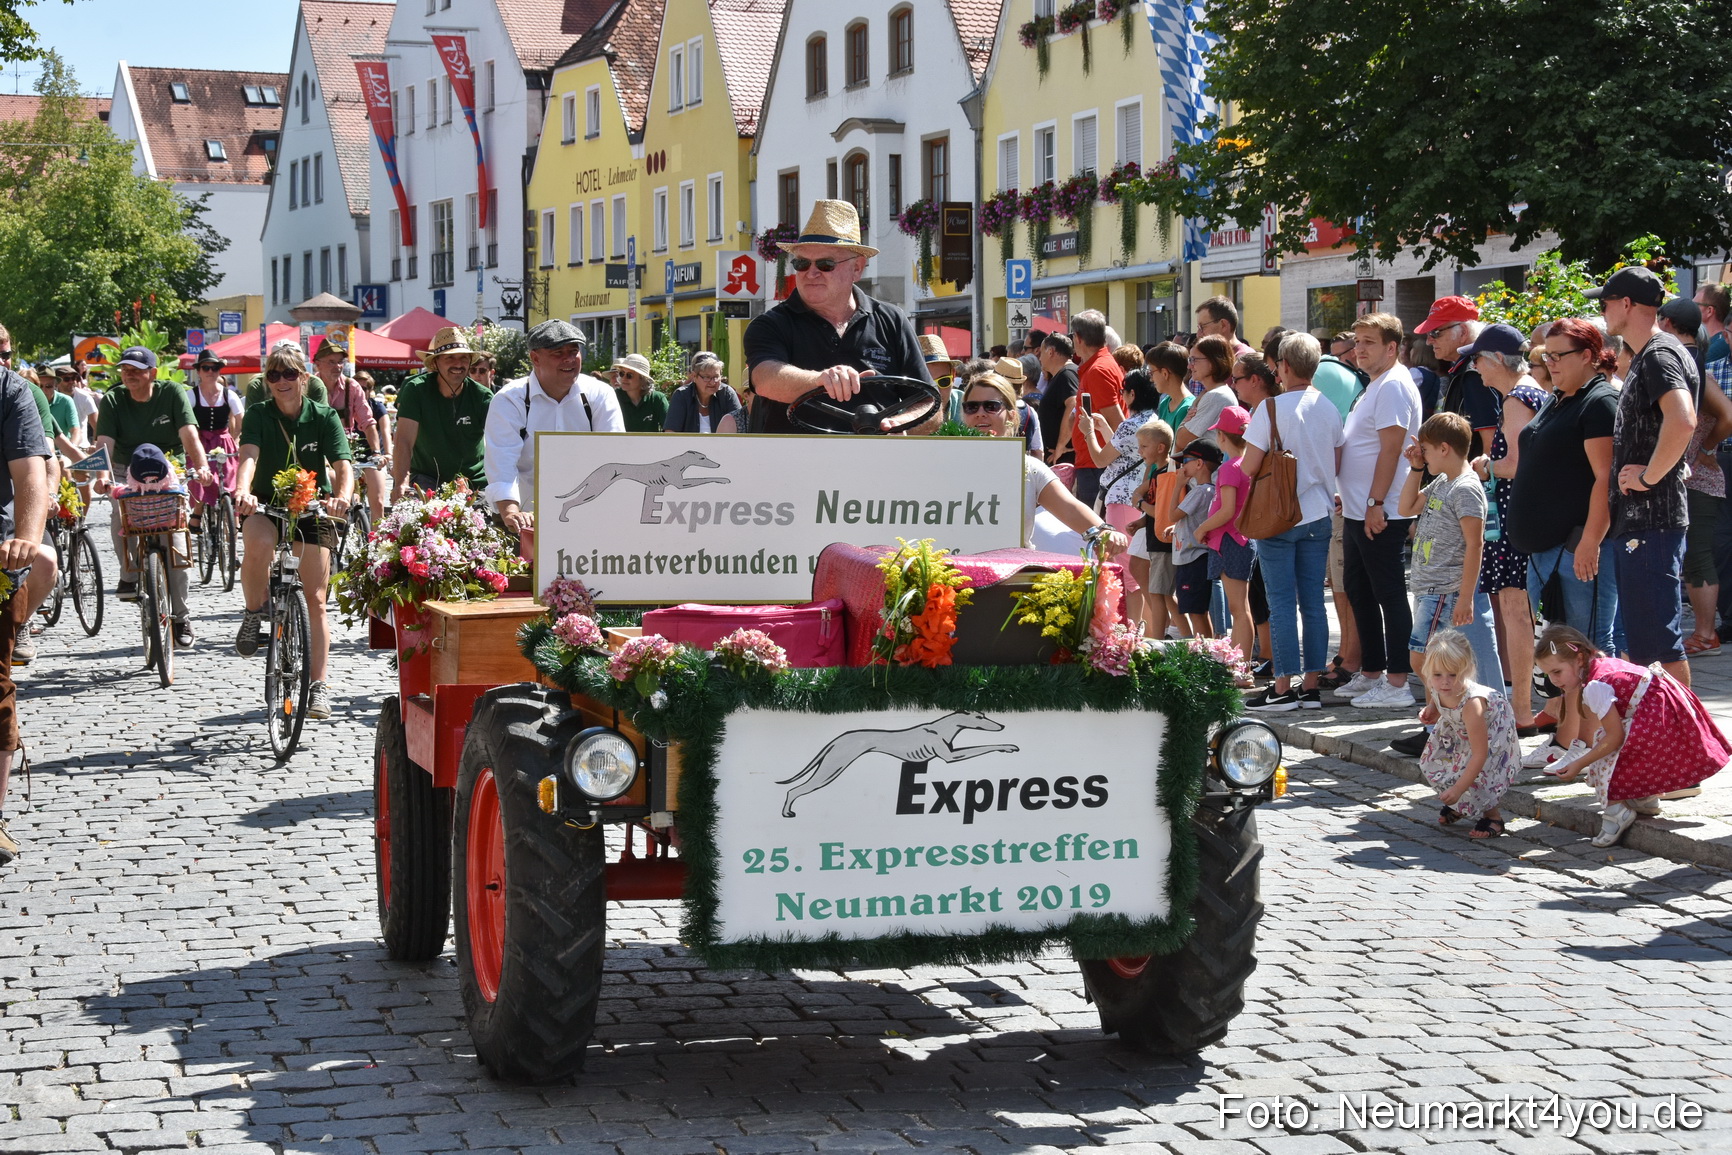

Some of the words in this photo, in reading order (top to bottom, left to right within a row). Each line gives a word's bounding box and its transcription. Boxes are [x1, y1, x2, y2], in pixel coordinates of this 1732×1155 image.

[576, 168, 601, 194] HOTEL
[608, 164, 637, 186] Lehmeier
[1210, 231, 1233, 248] RIALTO
[673, 266, 695, 283] AIFUN
[1012, 264, 1026, 294] P
[574, 291, 611, 308] Restaurant
[640, 486, 795, 533] Express
[816, 490, 1001, 525] Neumarkt
[557, 548, 798, 575] heimatverbunden
[895, 761, 1109, 825] Express
[742, 847, 803, 874] 25.
[819, 832, 1140, 875] Expresstreffen
[775, 885, 1004, 921] Neumarkt
[1017, 883, 1112, 912] 2019
